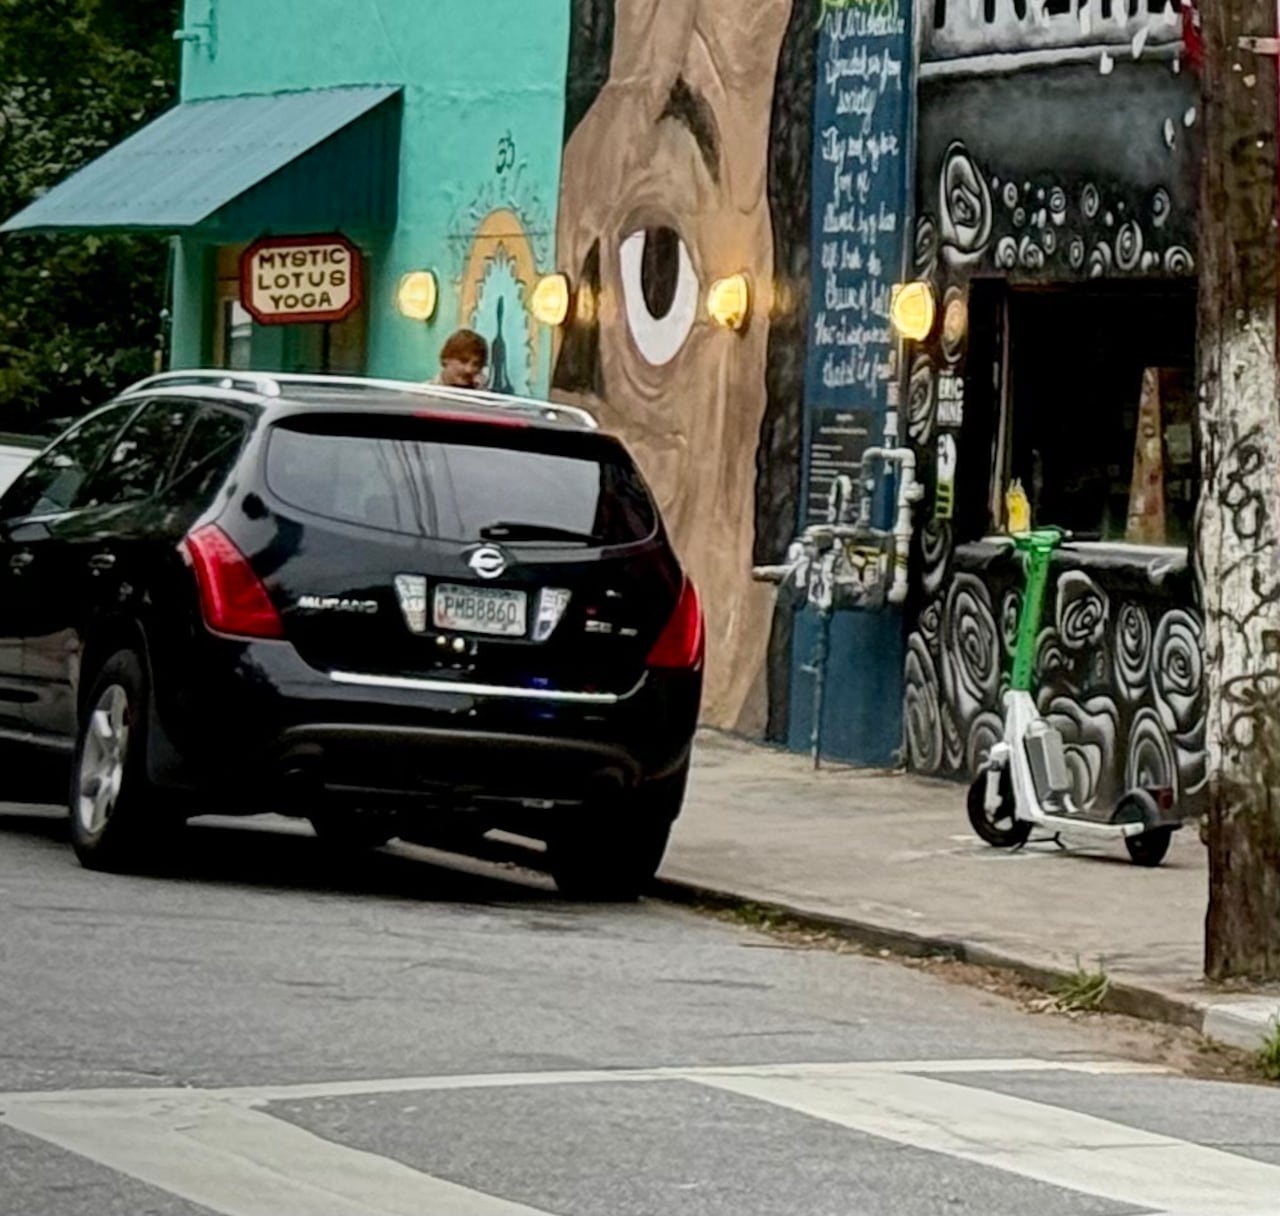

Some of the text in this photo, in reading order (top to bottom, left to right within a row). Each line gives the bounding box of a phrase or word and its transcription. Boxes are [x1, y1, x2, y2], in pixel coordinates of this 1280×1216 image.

[258, 248, 346, 269] MYSTIC
[258, 270, 346, 290] LOTUS
[269, 291, 333, 310] YOGA
